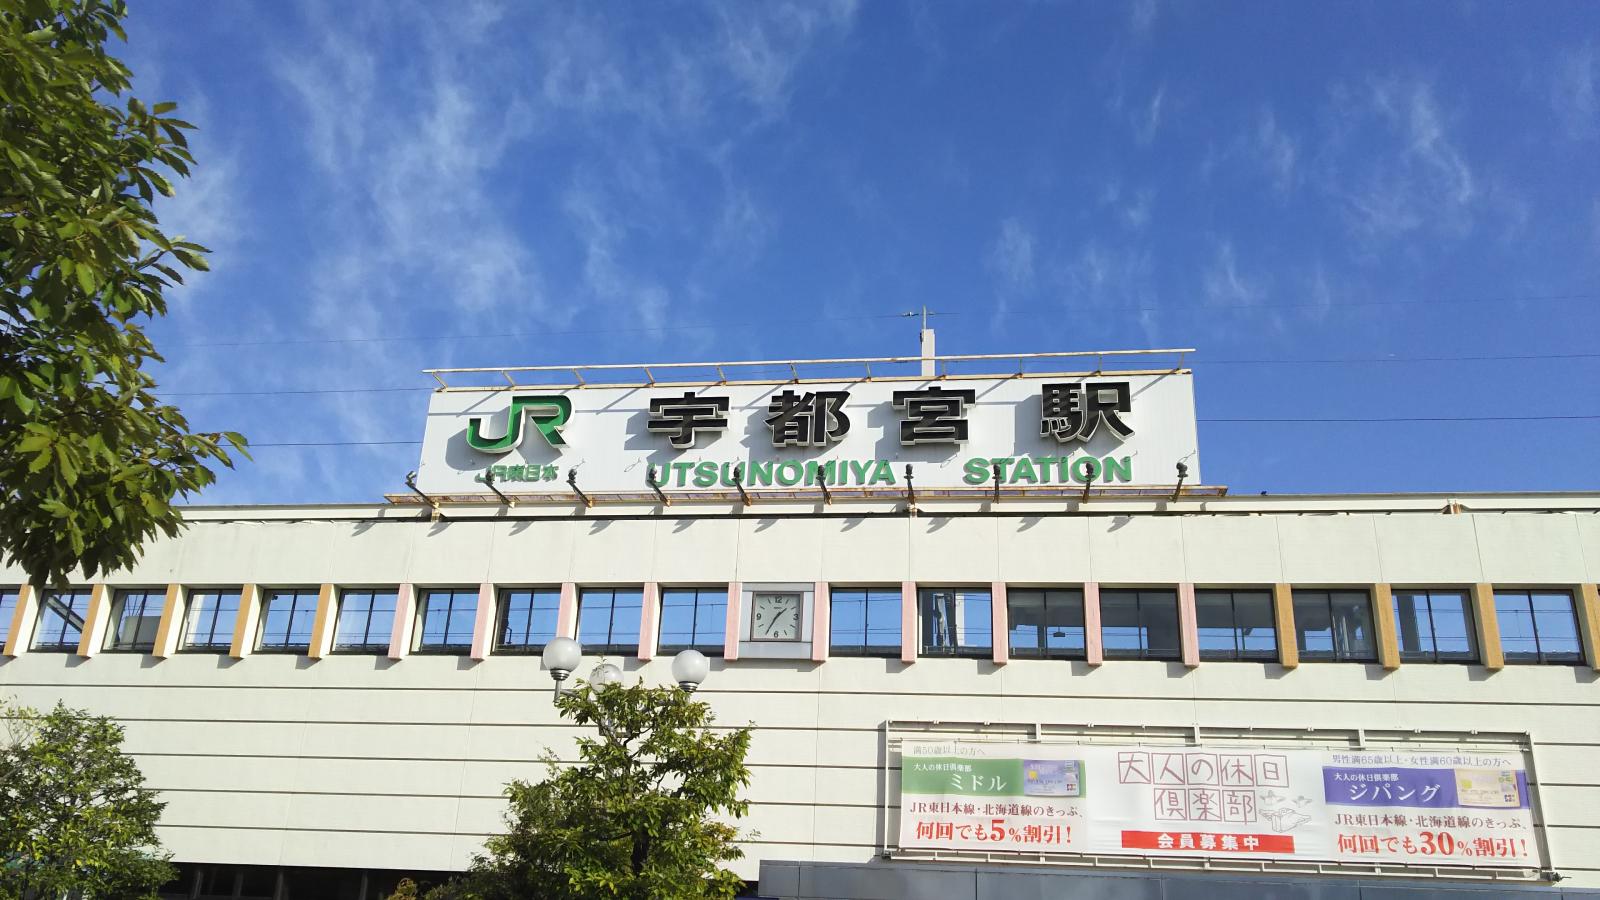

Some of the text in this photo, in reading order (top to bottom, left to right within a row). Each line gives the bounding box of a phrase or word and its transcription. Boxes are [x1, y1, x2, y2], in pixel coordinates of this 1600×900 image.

[466, 394, 574, 454] JR
[647, 381, 1136, 449] 宇都宮駅
[646, 455, 1133, 489] UTSUNOMIYA STATION
[950, 773, 1008, 792] ミドル
[1118, 753, 1281, 785] 大人の休日
[1155, 789, 1254, 824] 倶楽部
[1349, 783, 1441, 802] ジパング
[916, 819, 1072, 844] 何回でも5%割引!
[1158, 832, 1260, 851] 会員募集中
[1337, 831, 1529, 858] 何回でも30%割引!
